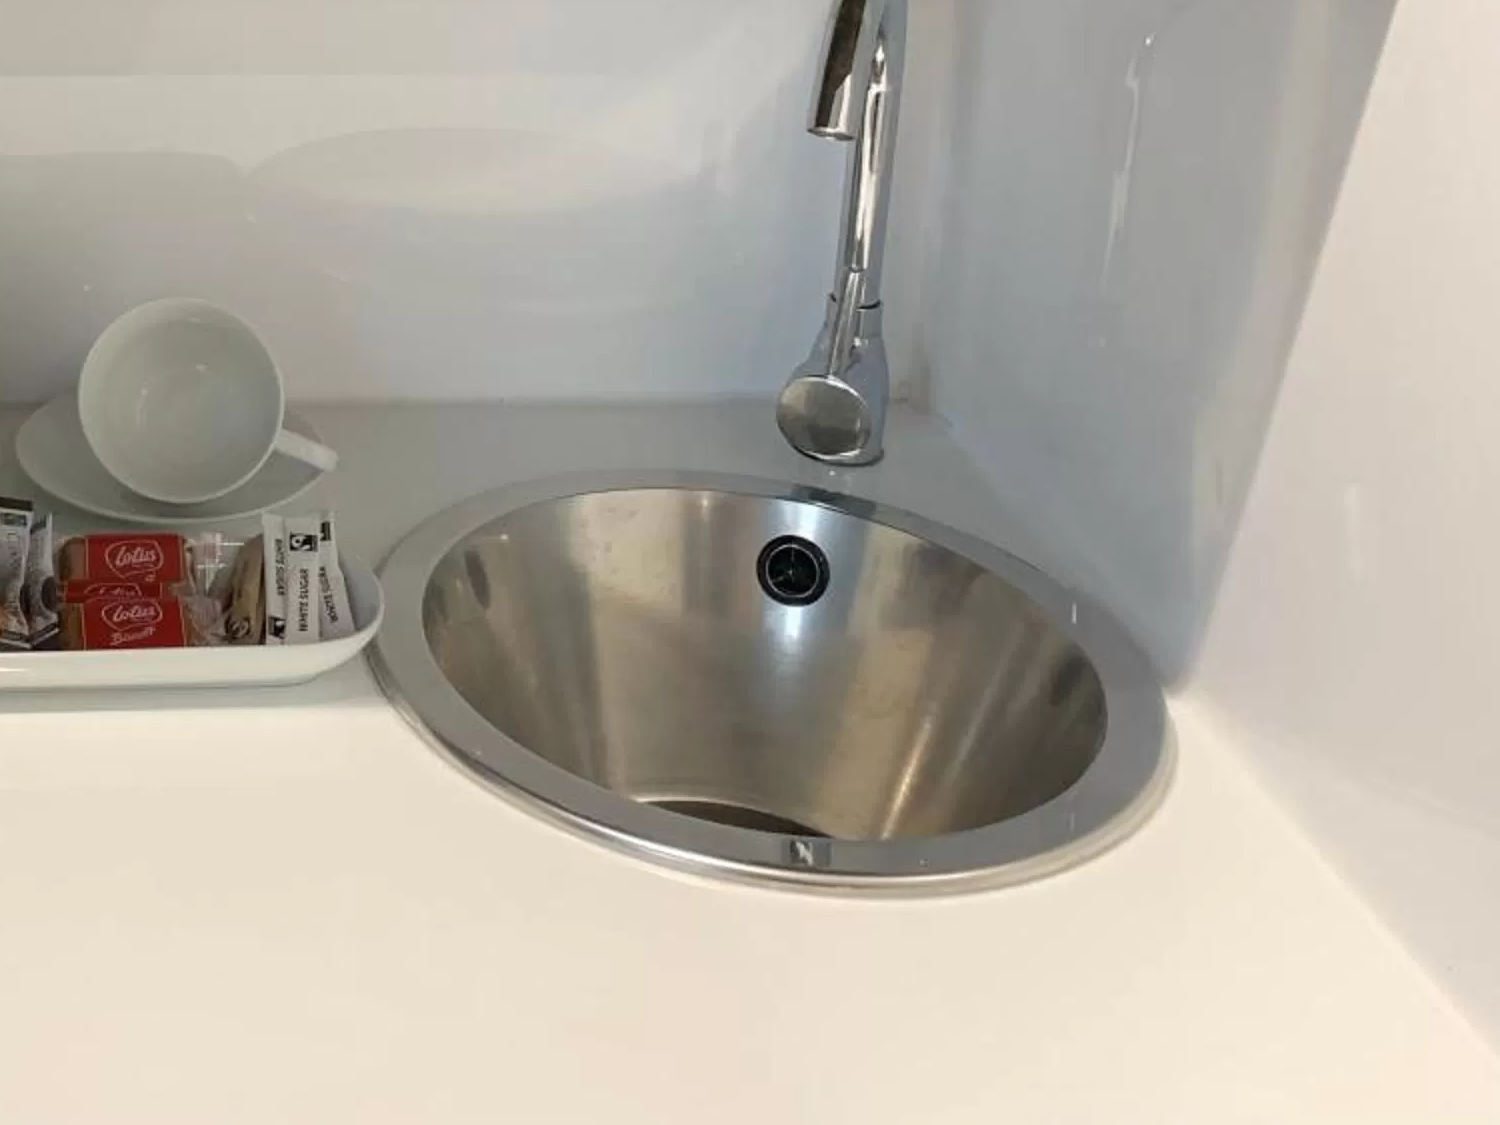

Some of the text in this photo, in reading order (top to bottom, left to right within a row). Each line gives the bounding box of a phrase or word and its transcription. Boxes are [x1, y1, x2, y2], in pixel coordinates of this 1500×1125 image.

[115, 545, 157, 568] Lotus
[298, 567, 309, 600] SUGAR
[112, 605, 156, 623] Lotus
